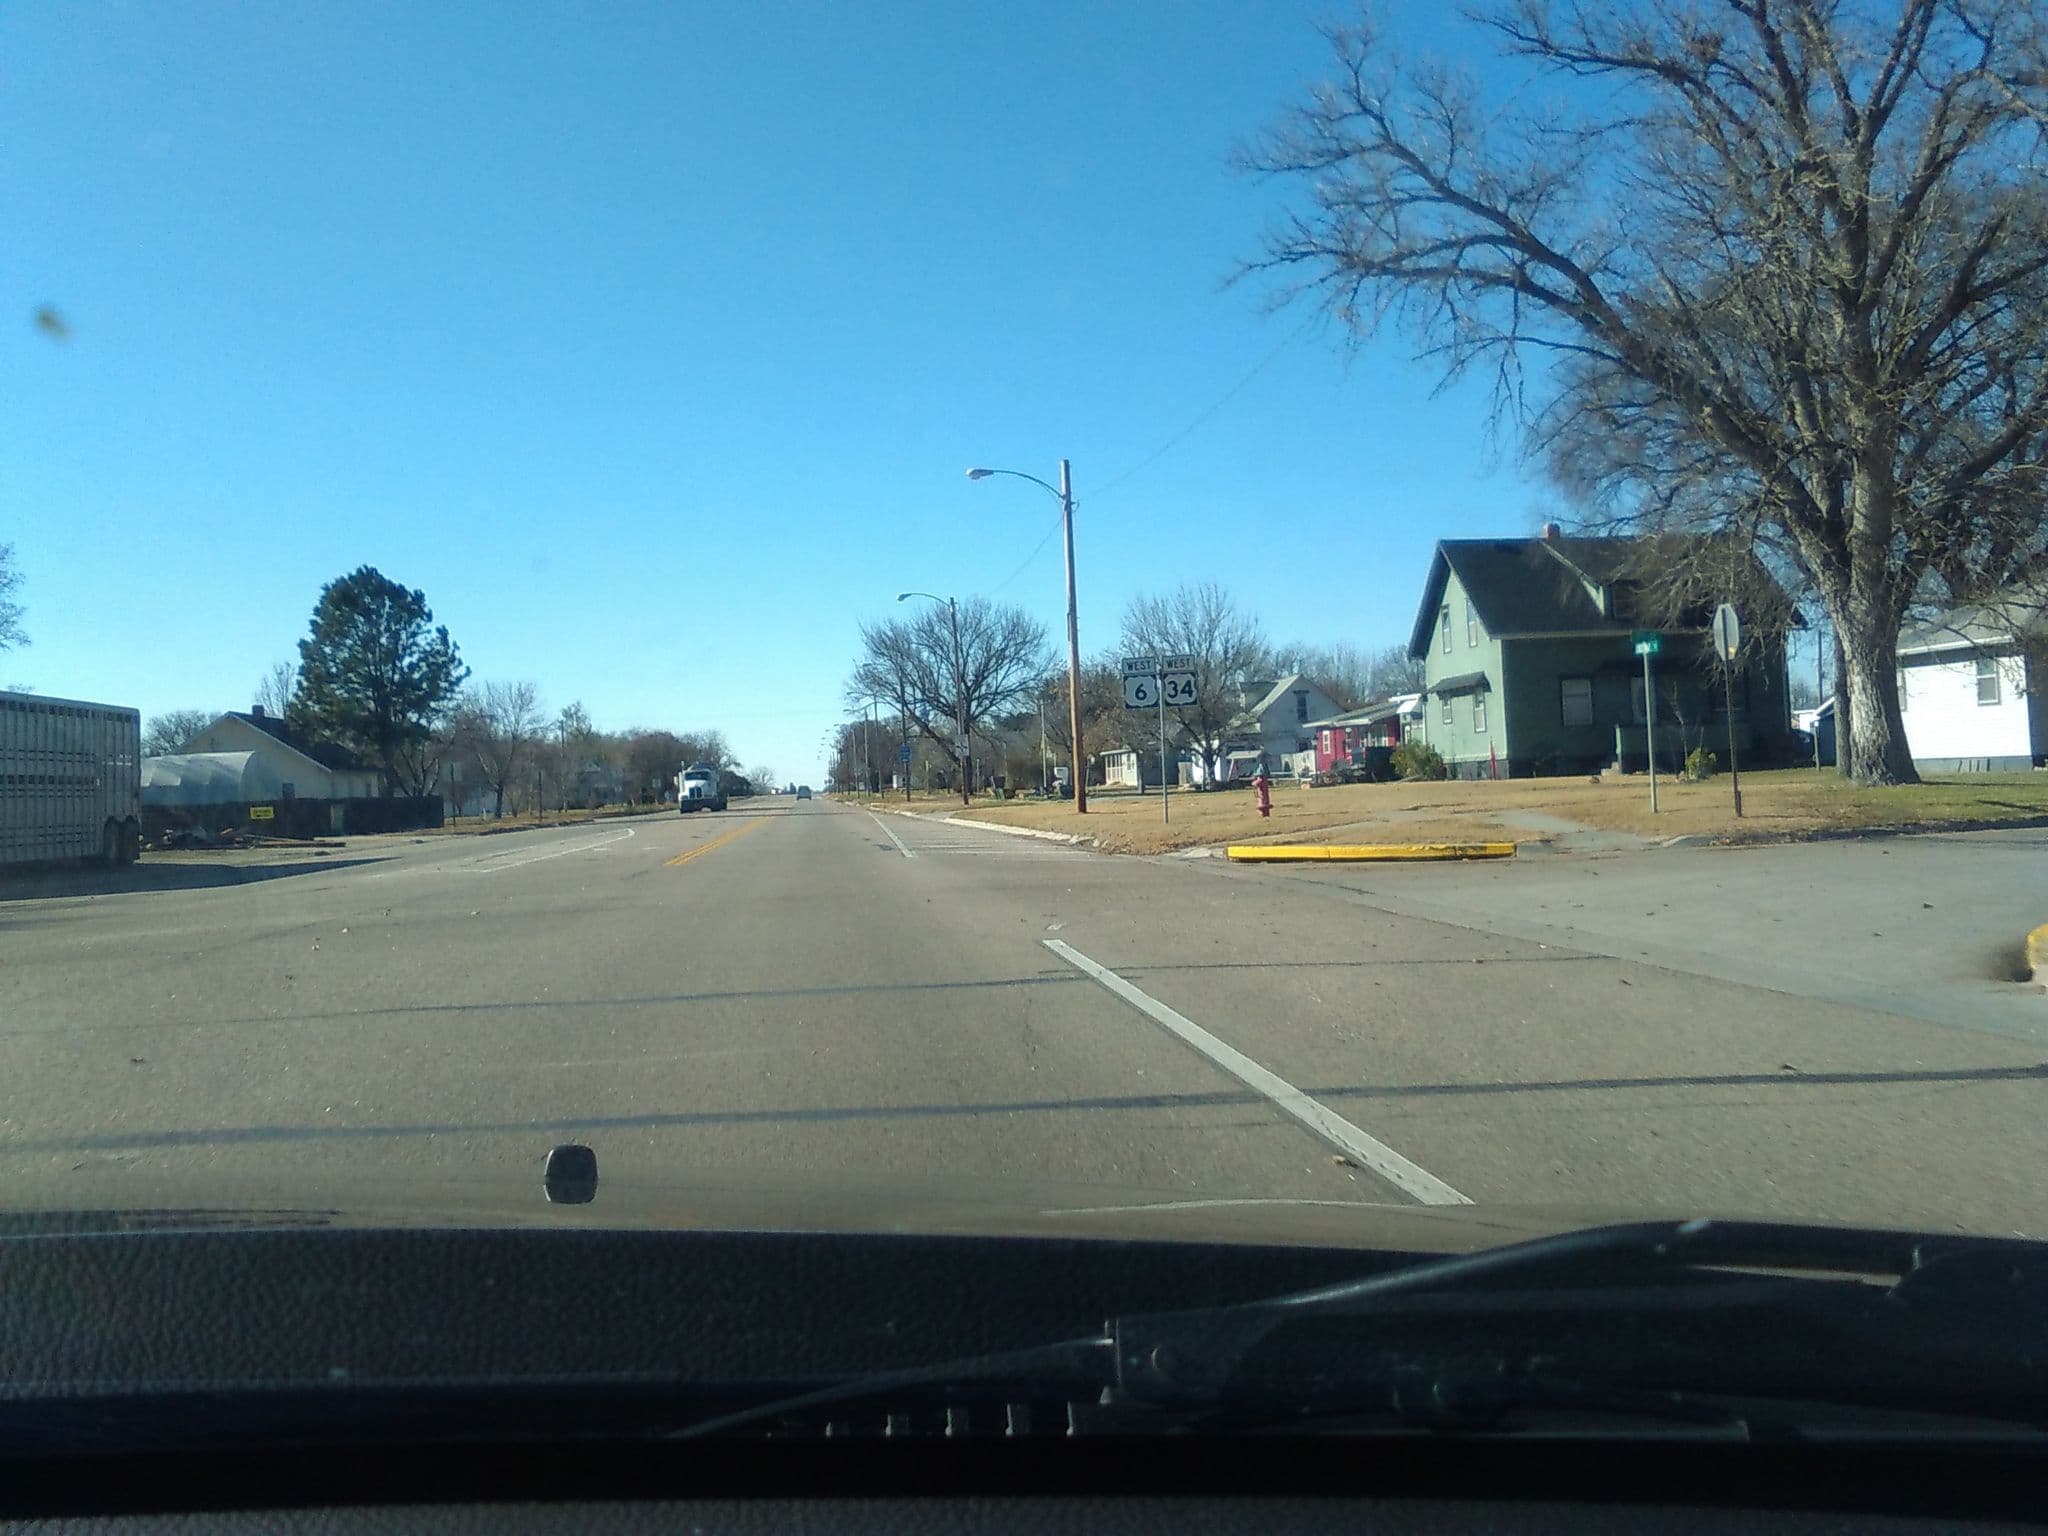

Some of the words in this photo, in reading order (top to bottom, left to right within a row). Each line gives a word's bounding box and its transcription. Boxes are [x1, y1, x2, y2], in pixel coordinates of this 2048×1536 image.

[1126, 660, 1151, 671] WEST
[1166, 658, 1190, 669] WEST
[1135, 683, 1147, 700] 6
[1167, 680, 1194, 699] 34
